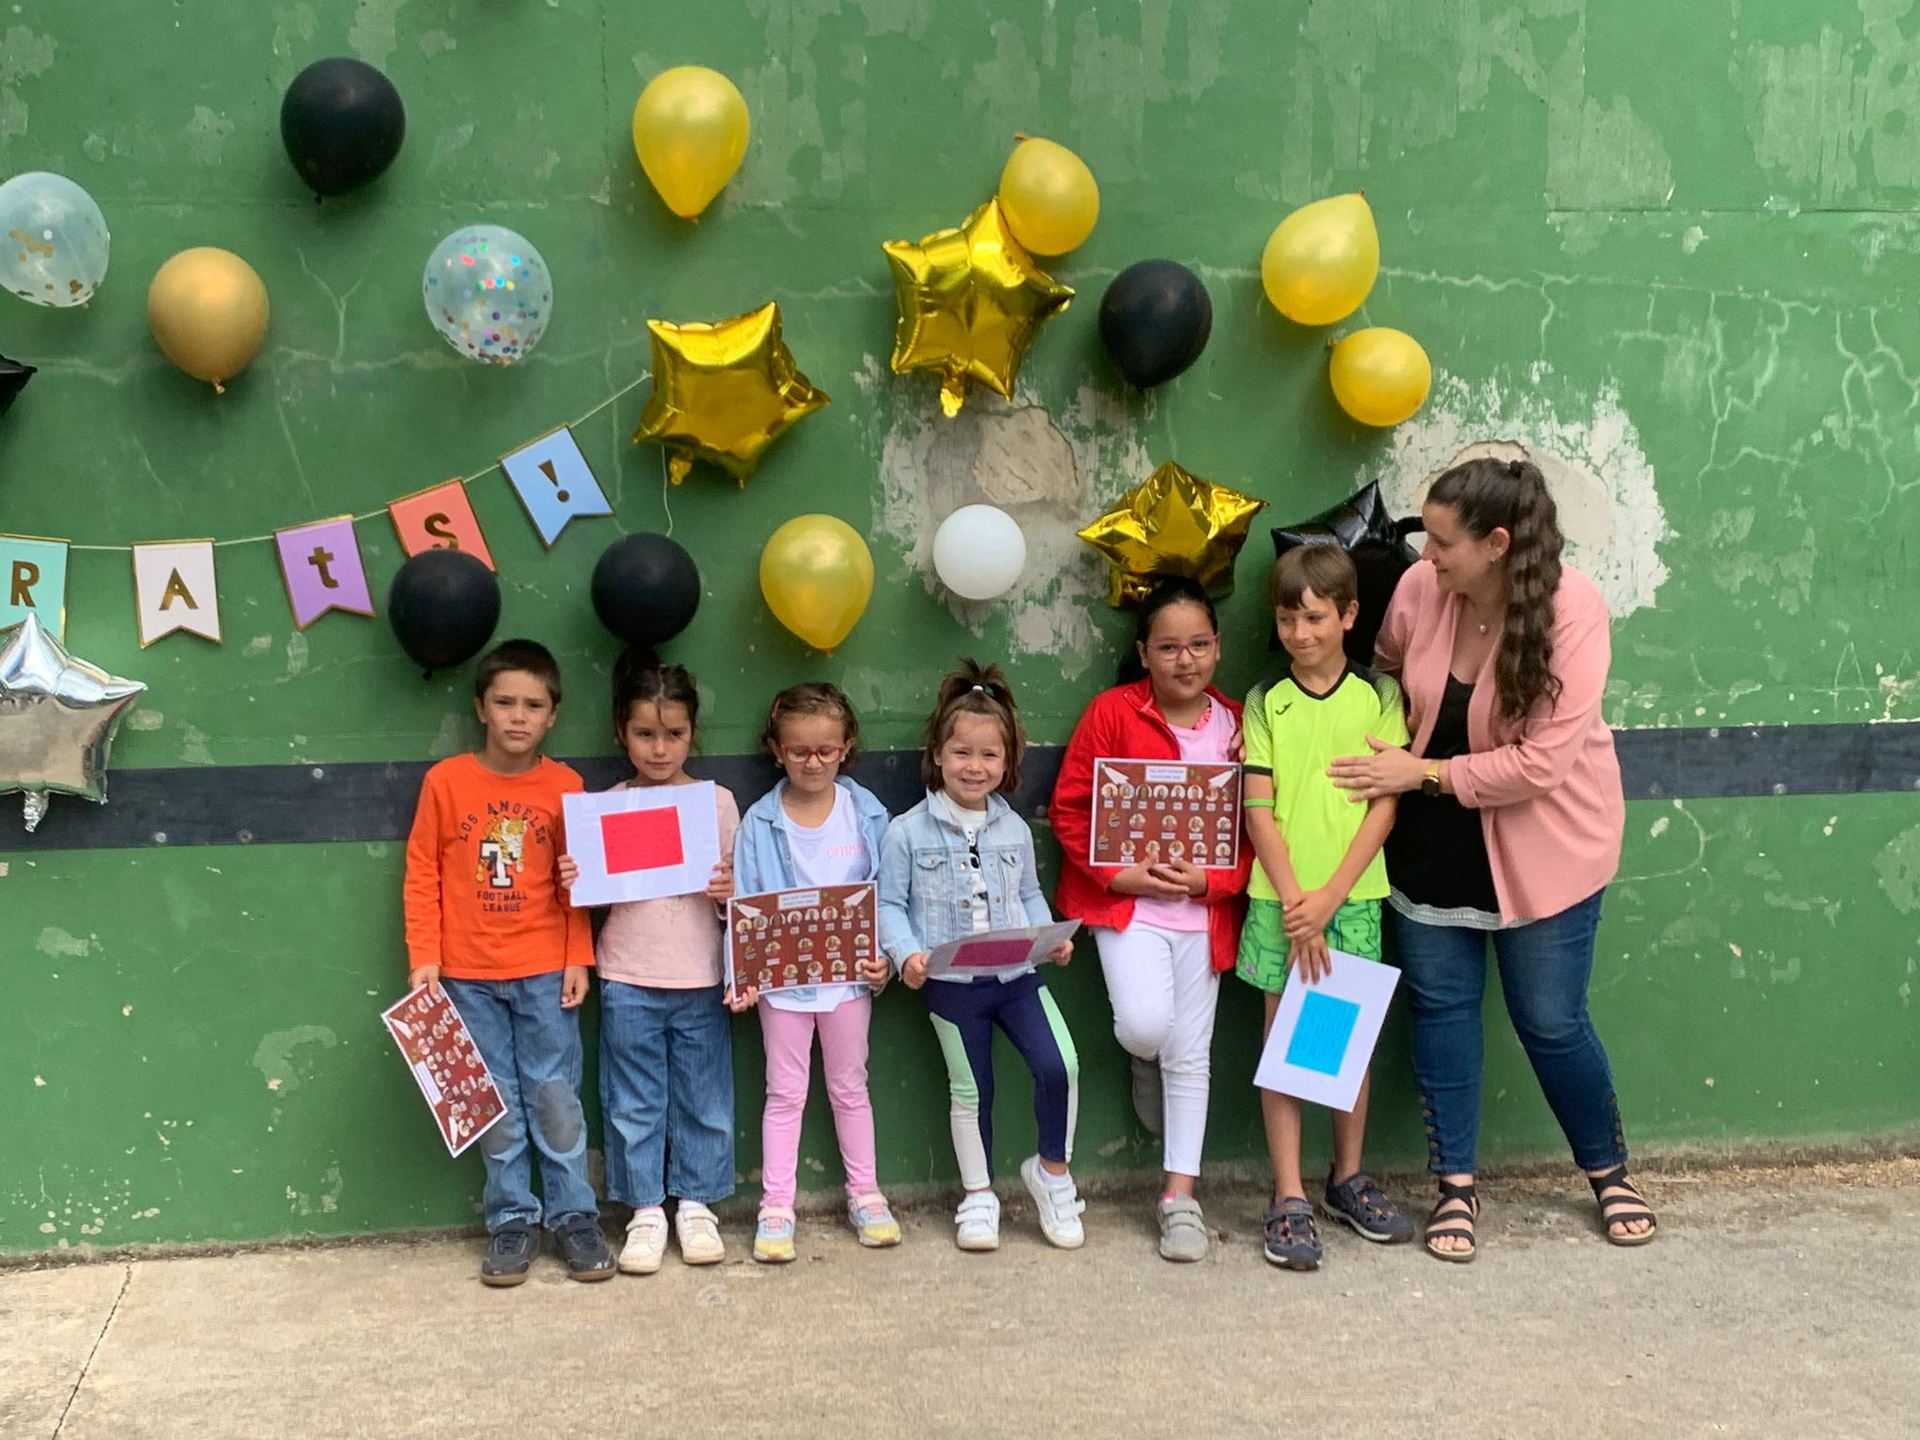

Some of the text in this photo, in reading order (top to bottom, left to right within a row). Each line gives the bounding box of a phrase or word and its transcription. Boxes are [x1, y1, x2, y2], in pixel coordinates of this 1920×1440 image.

[459, 813, 479, 843] LOS
[477, 889, 528, 901] FOOTBALL
[482, 902, 522, 913] LEAGUE
